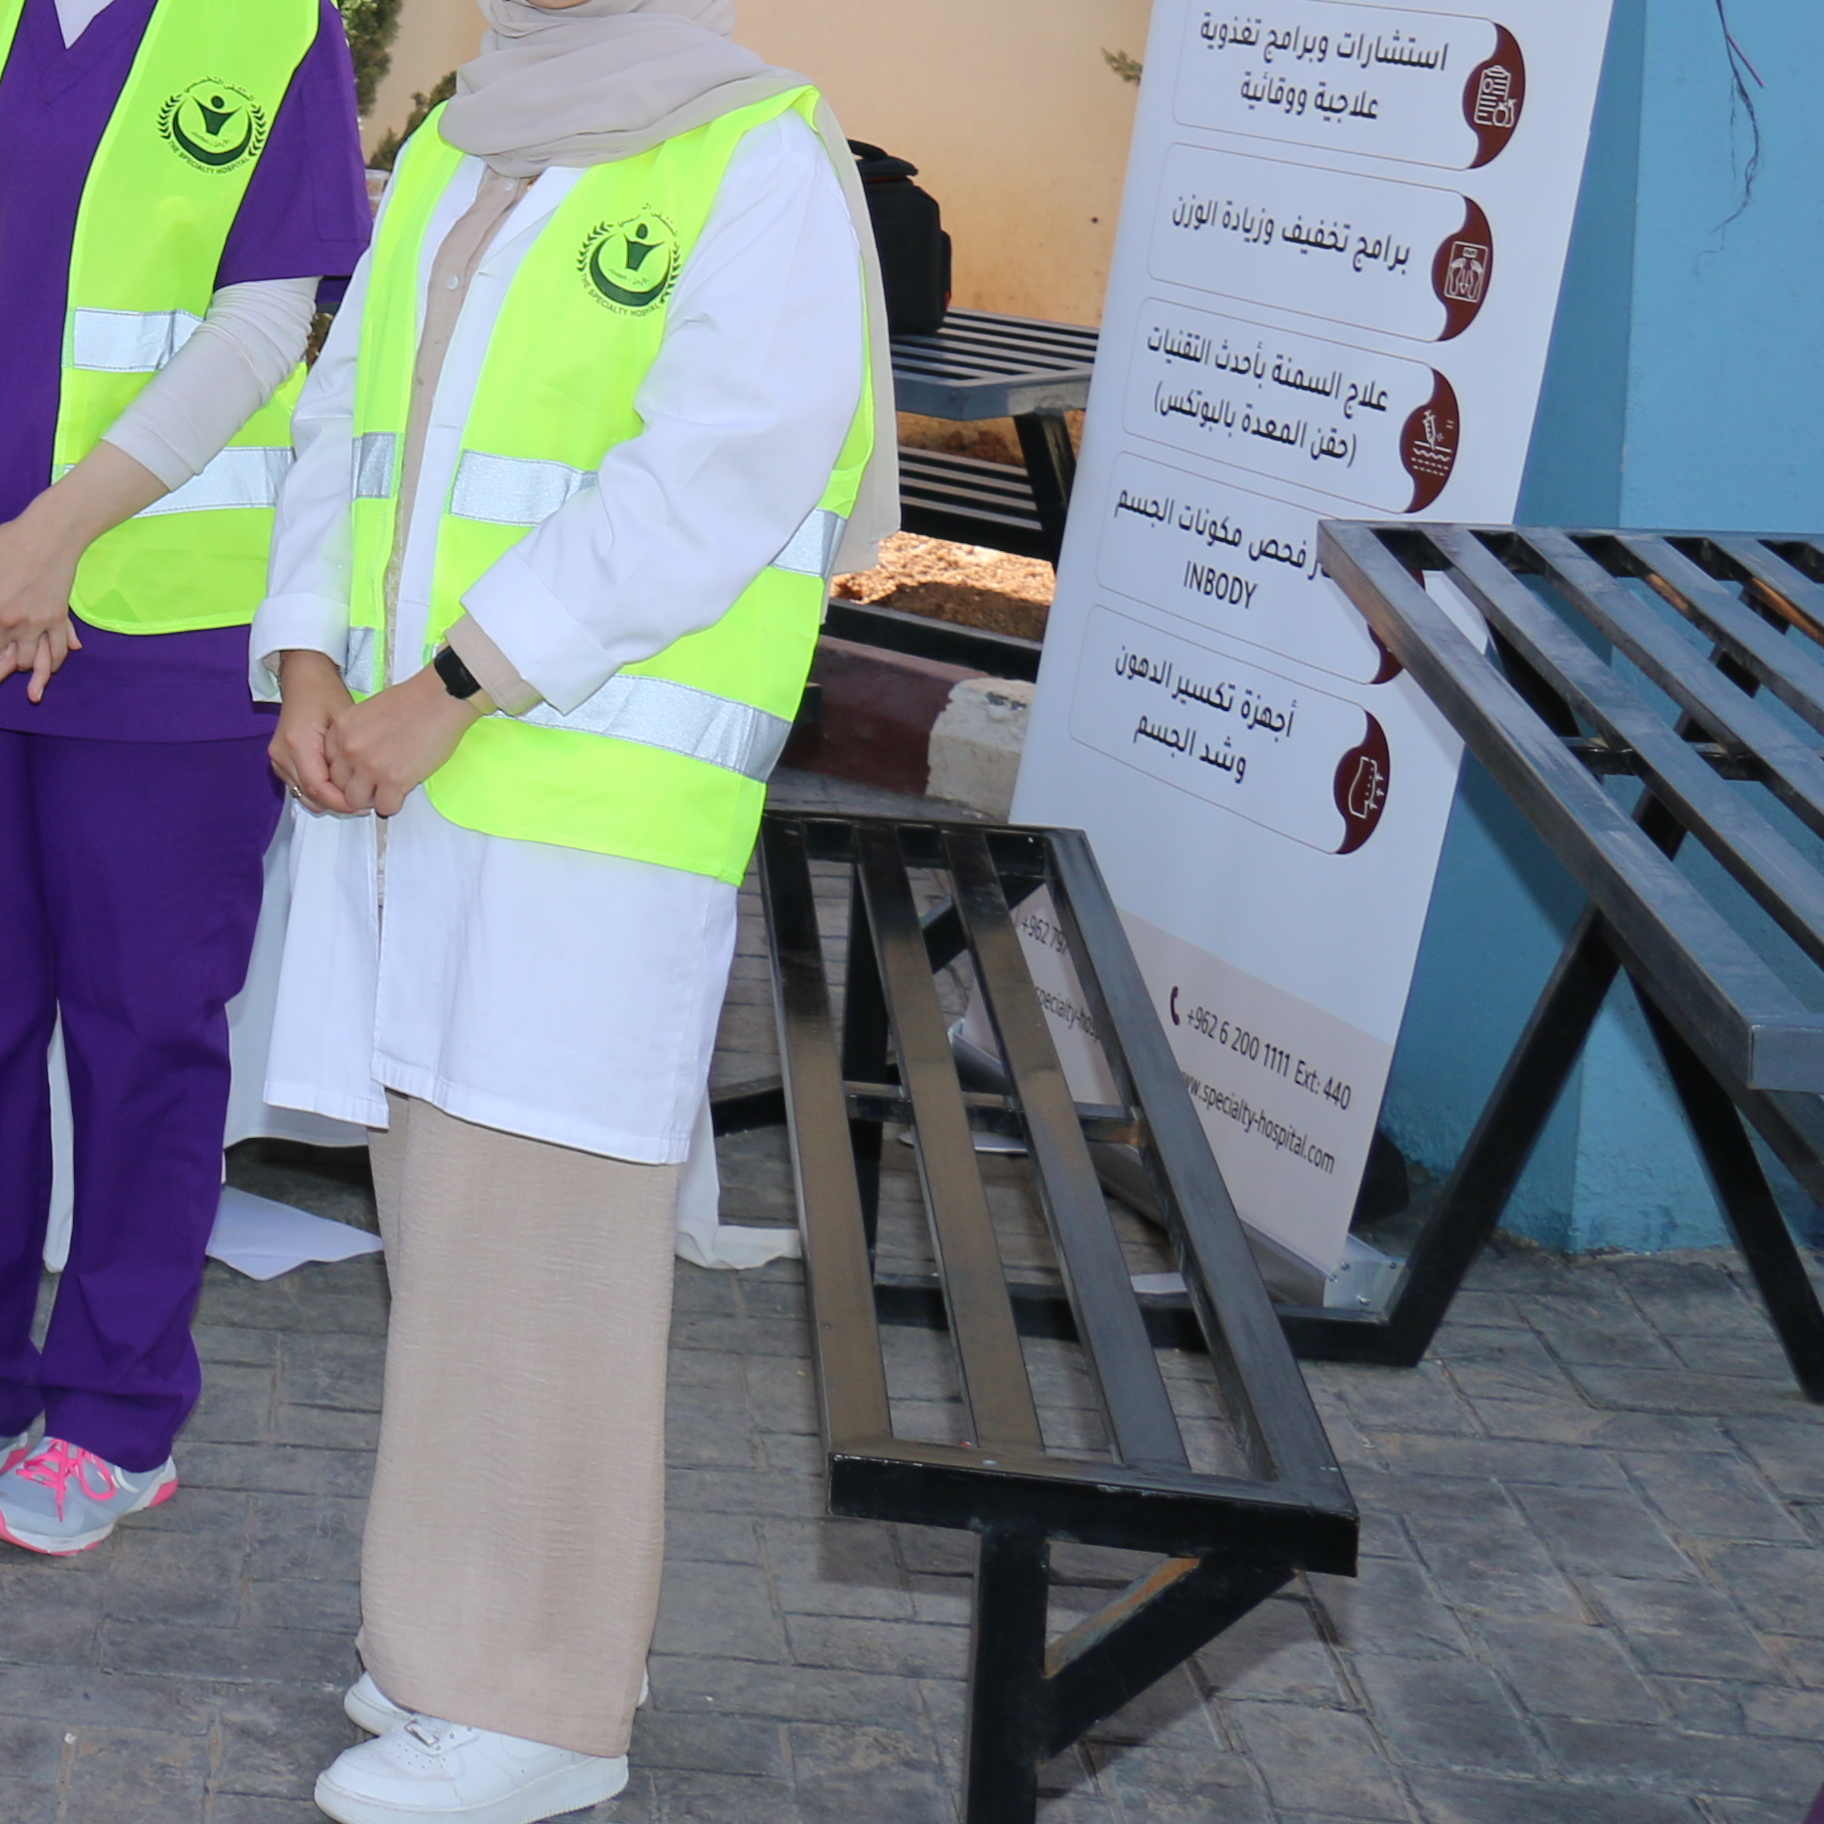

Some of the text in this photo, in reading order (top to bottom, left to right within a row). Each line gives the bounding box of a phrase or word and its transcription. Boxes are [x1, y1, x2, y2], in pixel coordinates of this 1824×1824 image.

[1200, 11, 1450, 71] استشارات وبرامج تغذوية
[1240, 70, 1379, 124] علاجية ووقائية
[1172, 194, 1411, 276] برامج تخفيف وزيادة الوزن
[1147, 326, 1389, 419] علاج السمنة بأحدث التقنيات
[1241, 402, 1308, 448] المعدة
[1310, 427, 1357, 469] (حقن
[1114, 489, 1308, 569] فحص مكونات الجسم
[1183, 560, 1258, 609] INBODY
[1115, 645, 1299, 743] أجهزة تكسير الدهون
[1132, 715, 1247, 784] وشد الجسم
[1021, 914, 1050, 946] +962
[1186, 1006, 1352, 1110] +962 6 200 1111 Ext: 440
